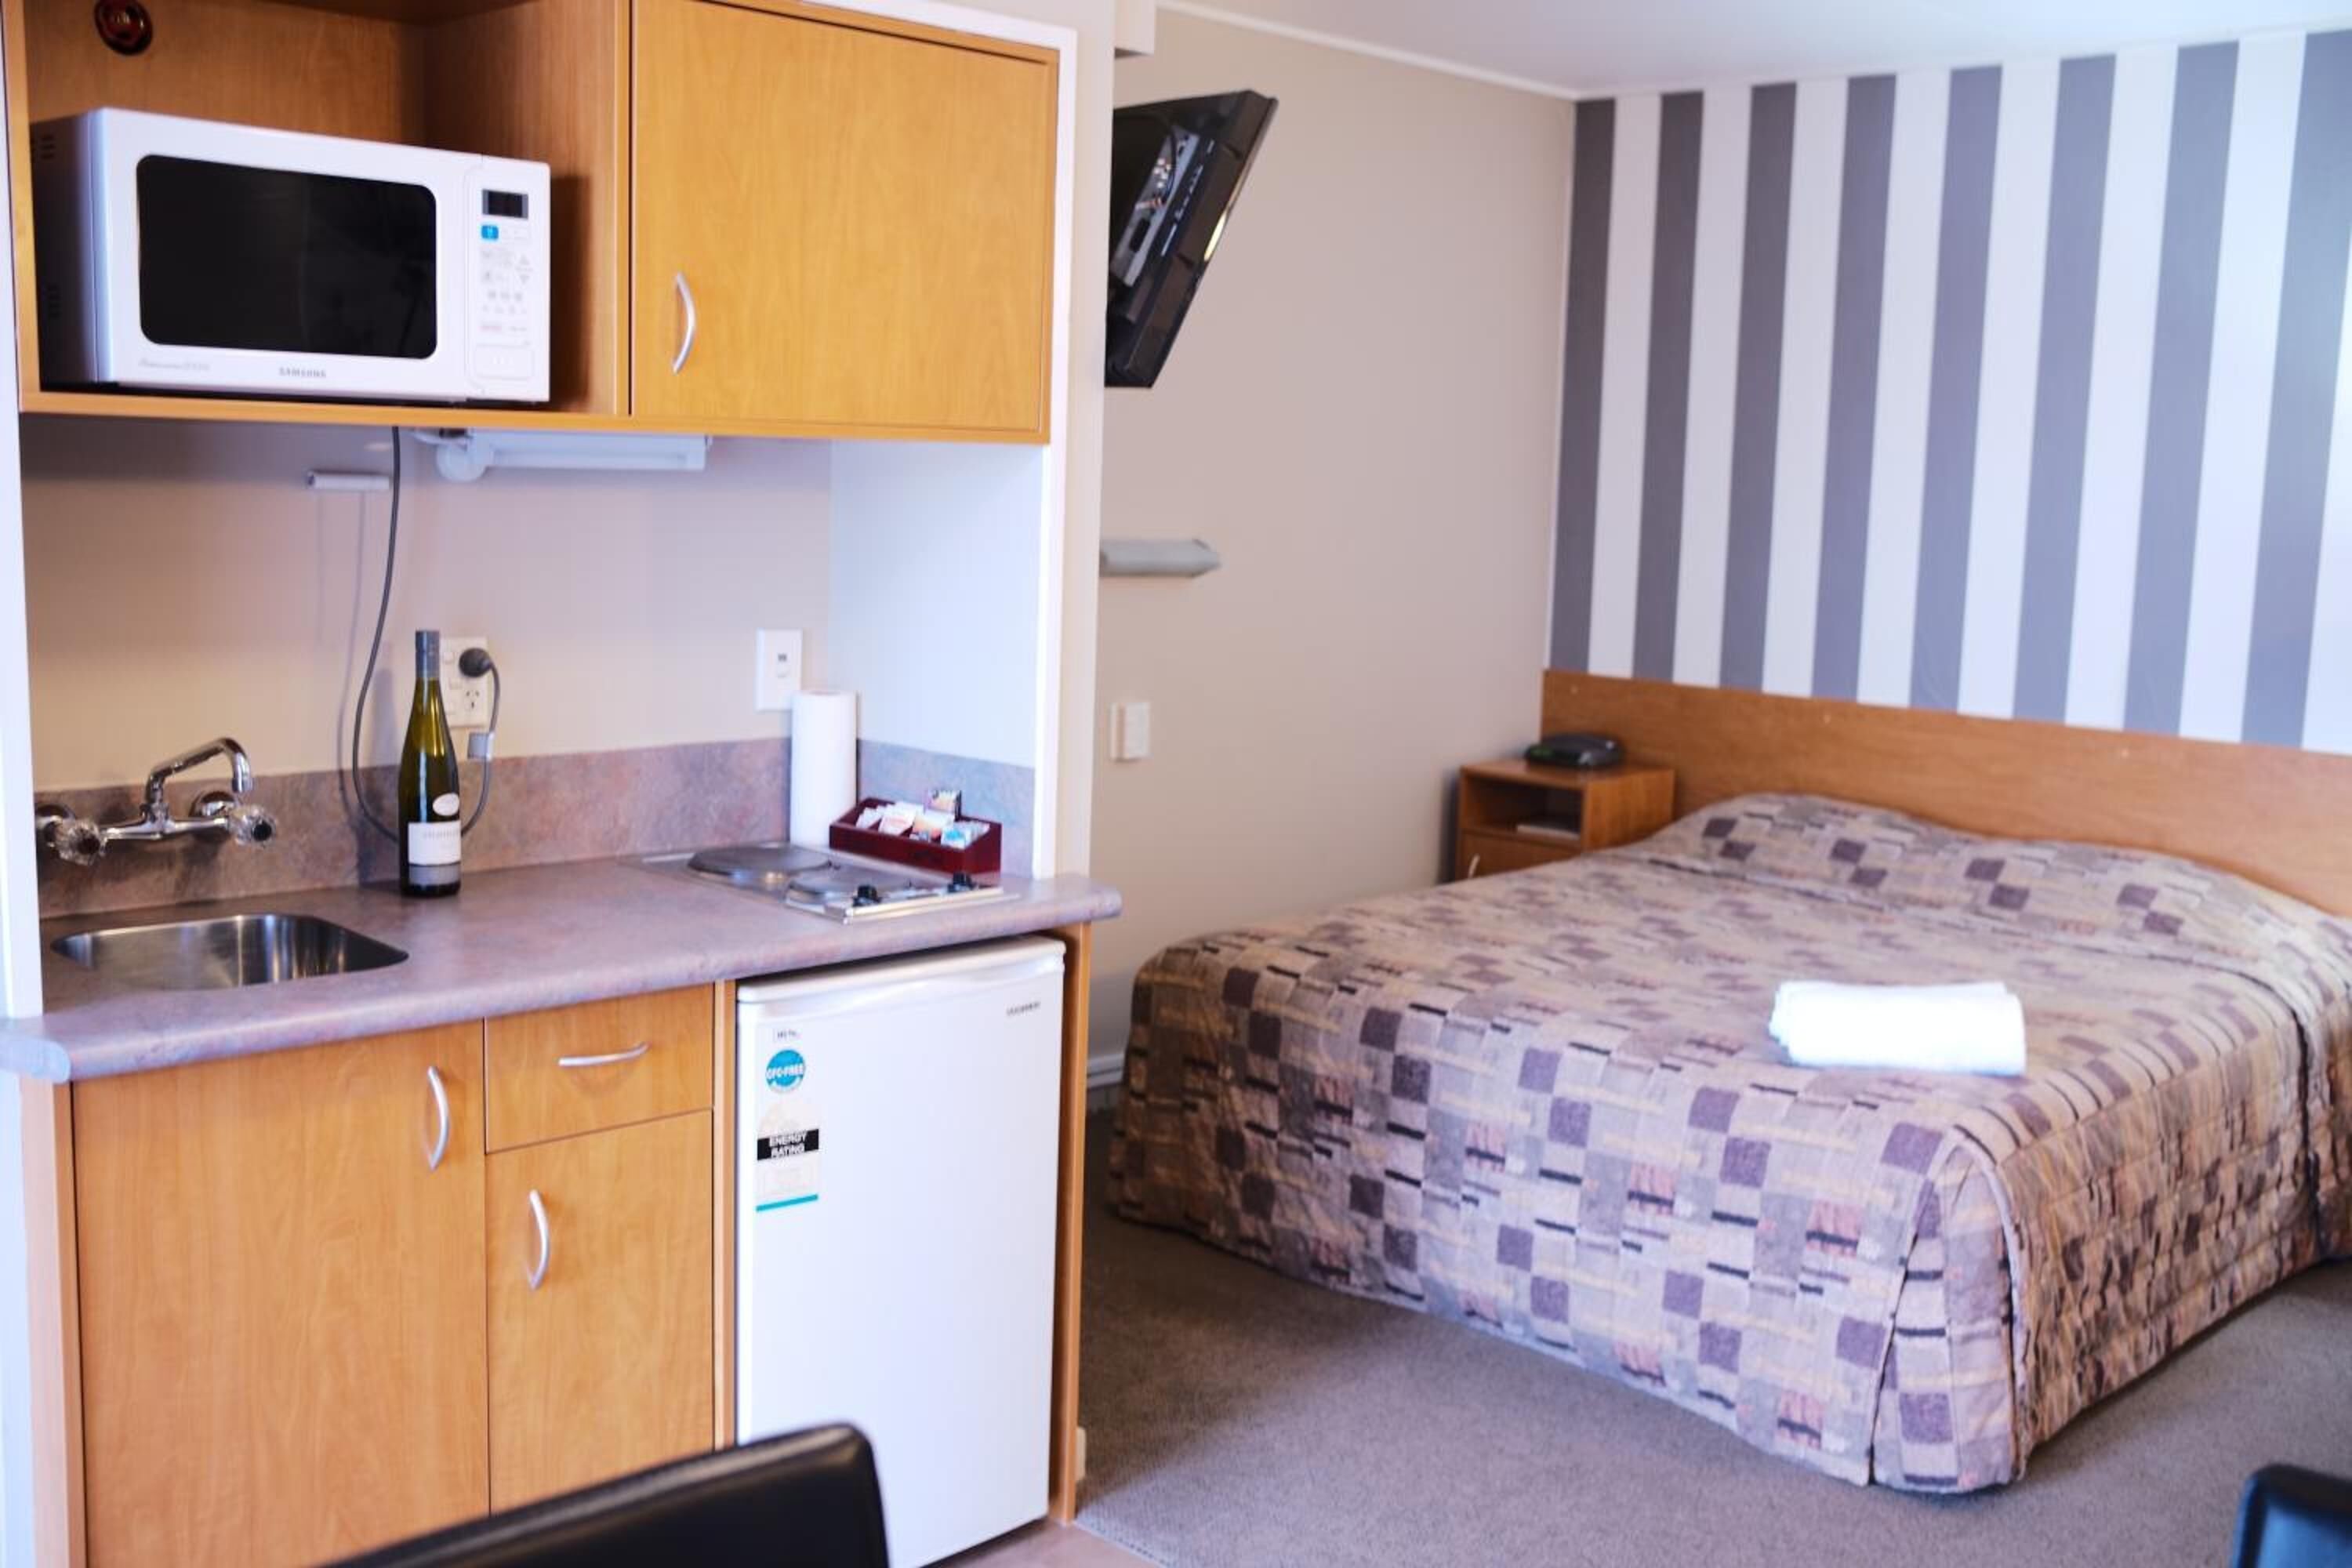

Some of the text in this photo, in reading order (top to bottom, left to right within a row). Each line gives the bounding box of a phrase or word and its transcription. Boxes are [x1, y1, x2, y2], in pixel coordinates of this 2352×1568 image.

[278, 366, 326, 378] SAMSUNG
[770, 1131, 807, 1147] ENERGY
[771, 1144, 805, 1158] RATING
